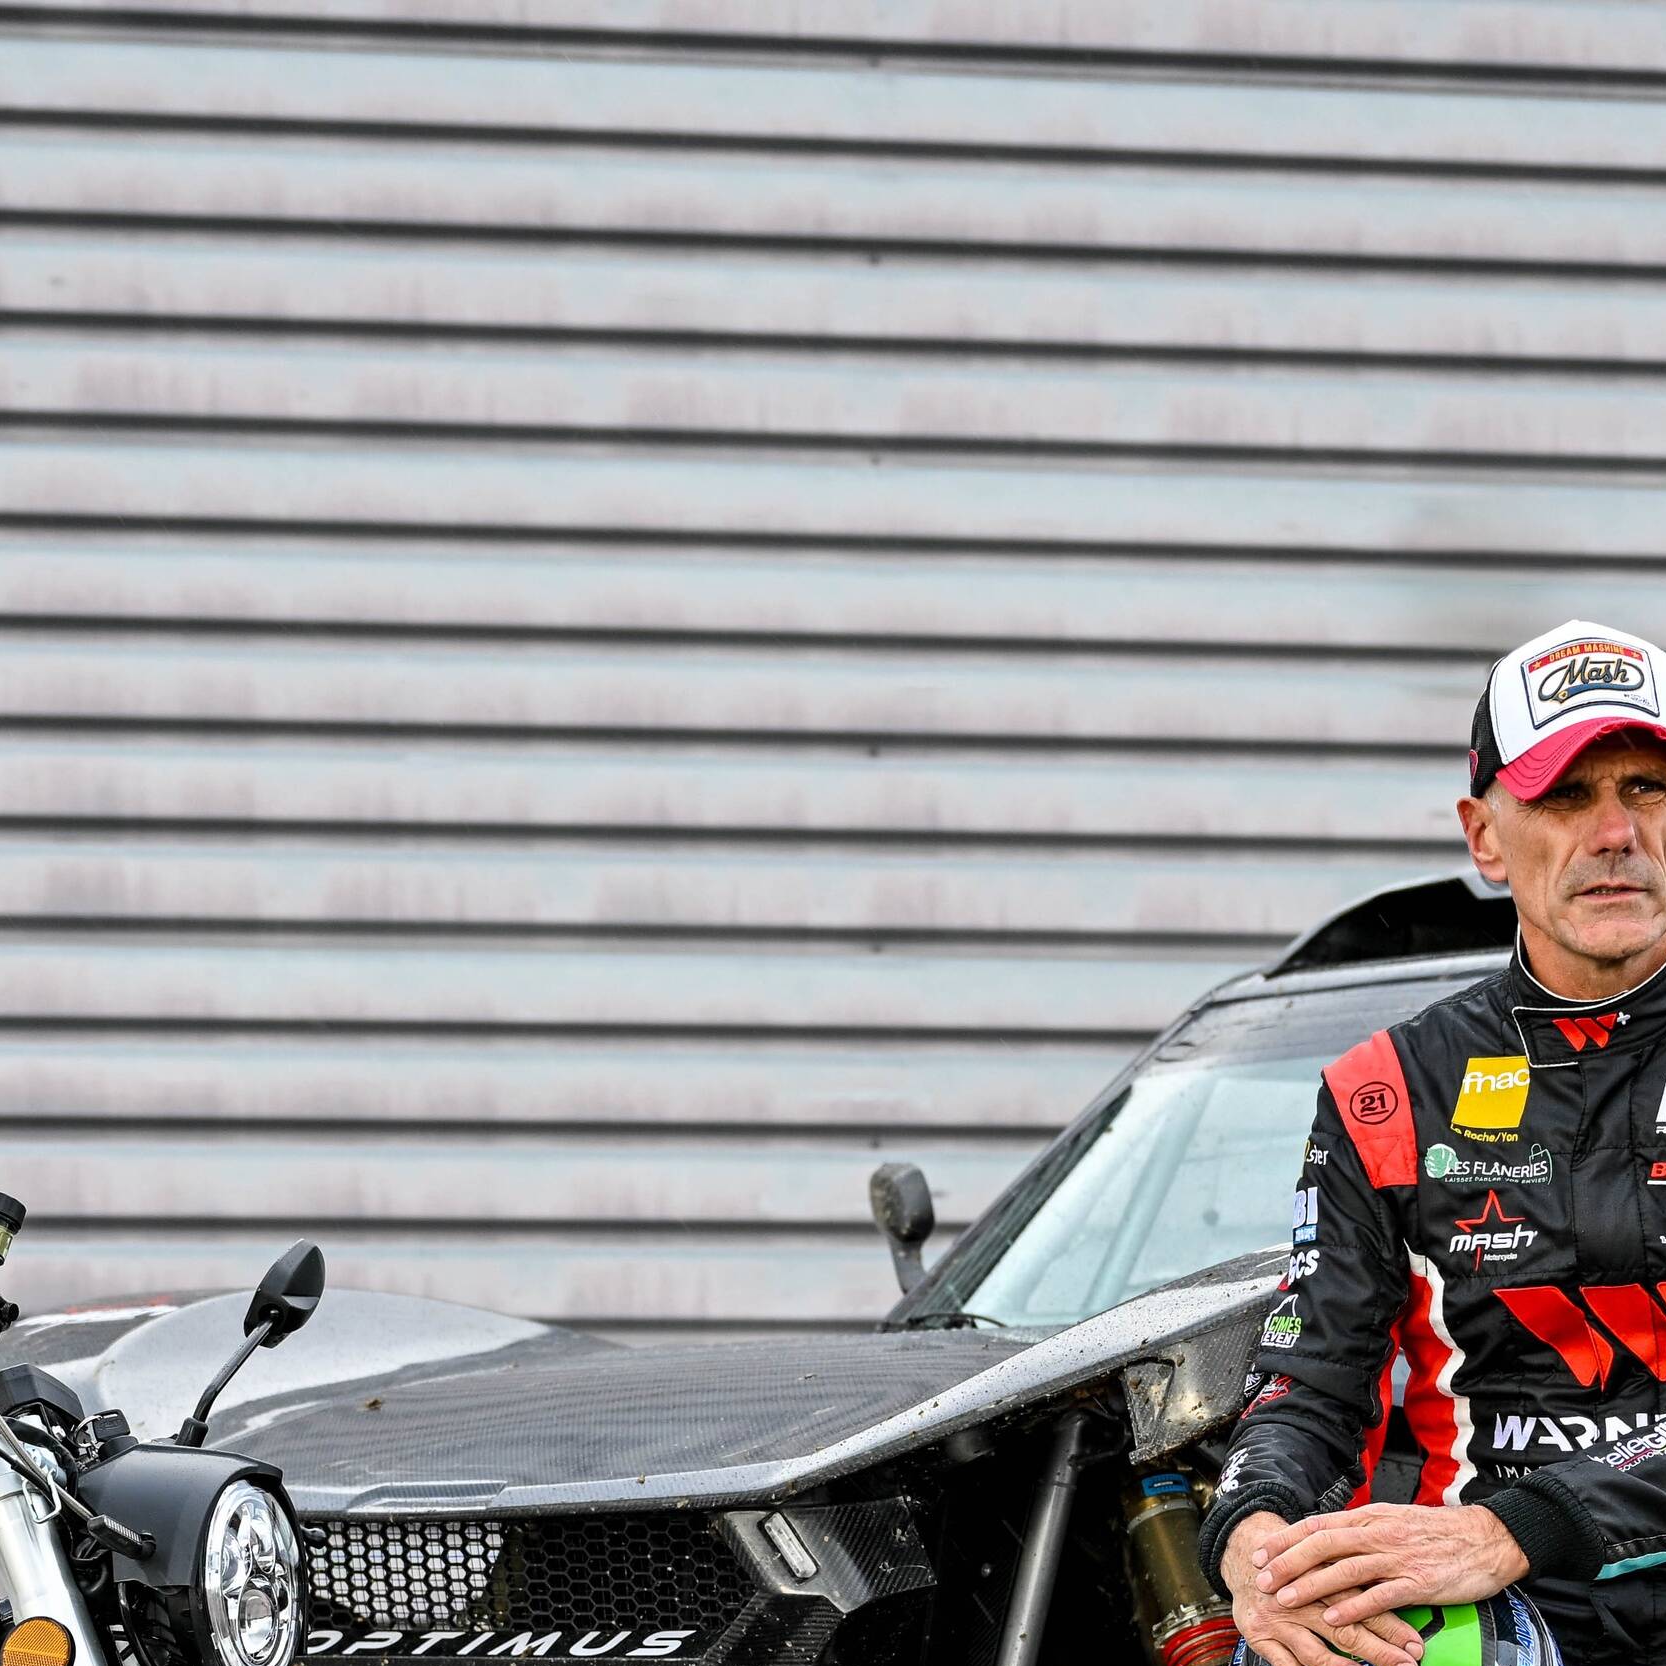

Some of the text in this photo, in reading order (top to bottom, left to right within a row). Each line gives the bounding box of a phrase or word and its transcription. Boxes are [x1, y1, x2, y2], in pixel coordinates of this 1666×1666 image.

[1549, 645, 1581, 662] DREAM
[1554, 656, 1630, 690] Mash
[1463, 1068, 1531, 1094] fnac
[1464, 1130, 1518, 1142] Roche/Yon
[1445, 1160, 1548, 1178] LES FLÂNERIES
[1268, 1316, 1302, 1335] CIMES
[1263, 1332, 1300, 1347] EVENT
[308, 1630, 697, 1656] OPTIMUS
